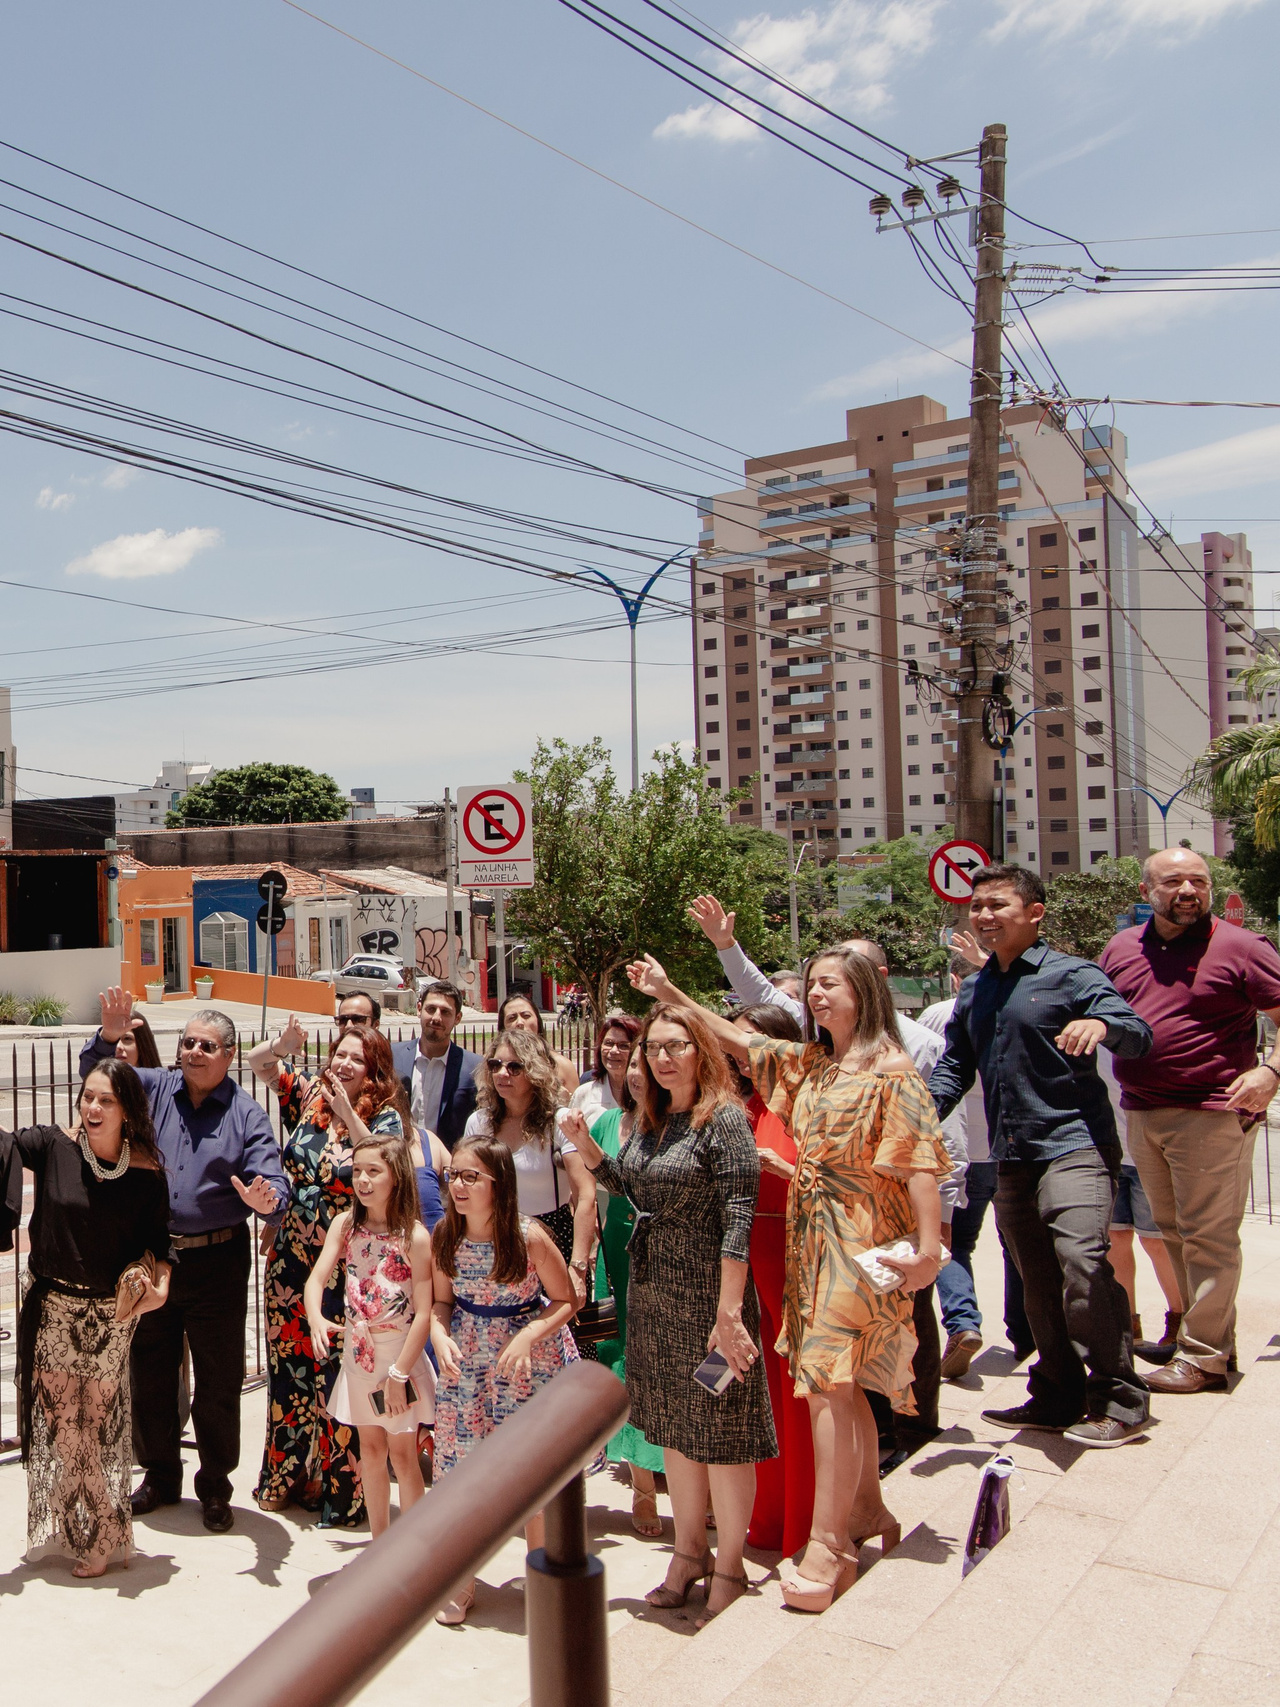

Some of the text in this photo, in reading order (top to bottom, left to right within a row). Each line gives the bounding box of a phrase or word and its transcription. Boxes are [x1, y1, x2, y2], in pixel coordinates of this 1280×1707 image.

[483, 804, 505, 840] E
[474, 863, 518, 872] NA LINHA
[473, 874, 519, 882] AMARELA
[1226, 908, 1243, 919] PARE
